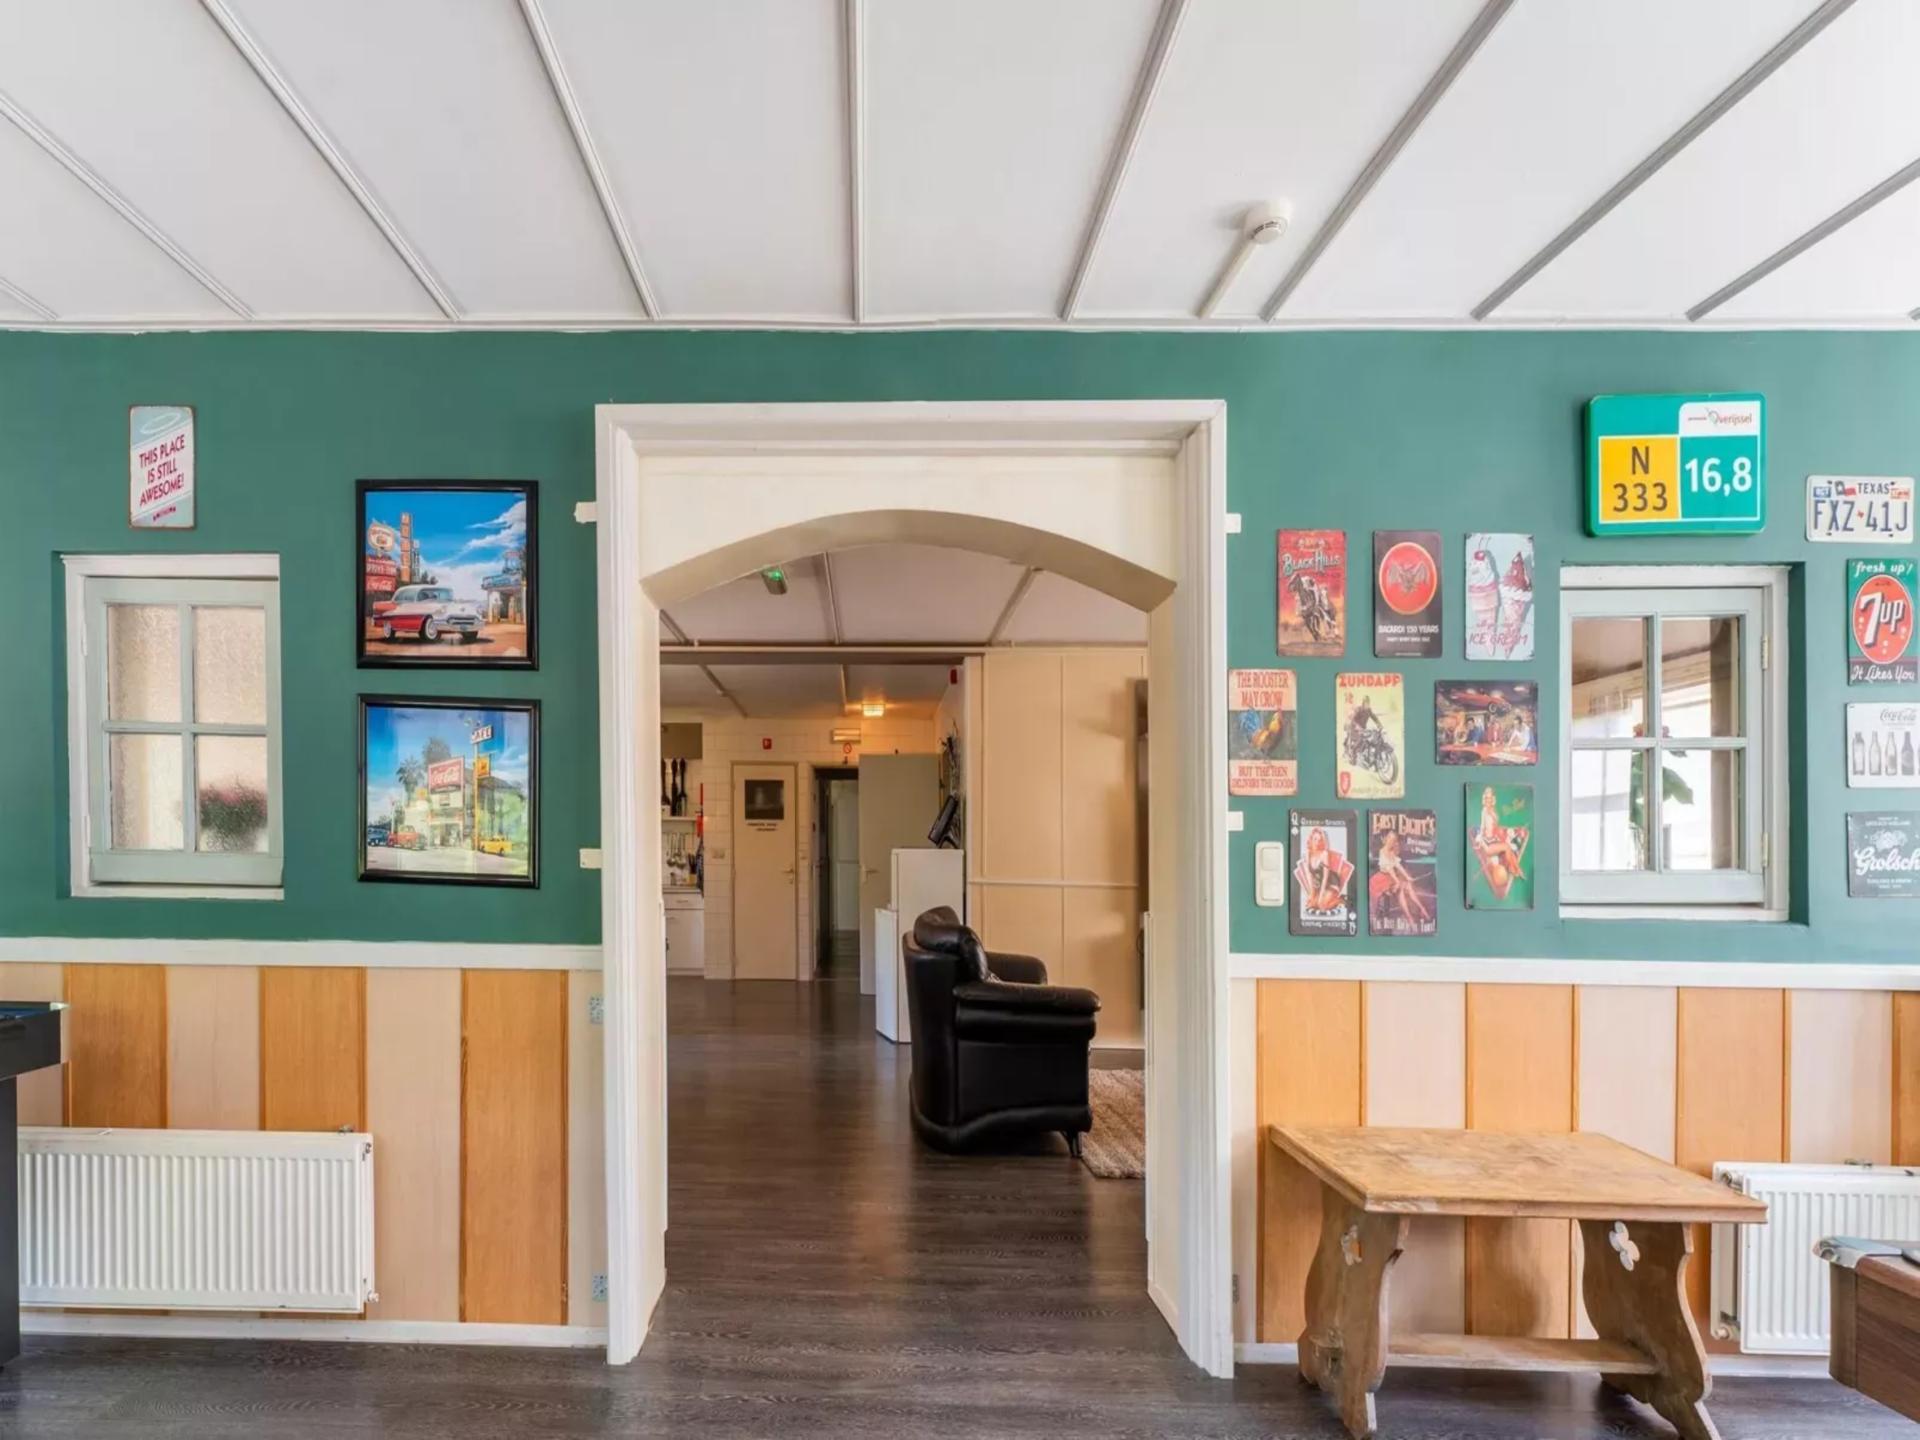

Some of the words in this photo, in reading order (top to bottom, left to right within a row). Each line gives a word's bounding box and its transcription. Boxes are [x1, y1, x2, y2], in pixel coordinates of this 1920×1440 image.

[139, 447, 158, 468] THIS
[160, 434, 185, 459] PLACE
[1631, 446, 1650, 475] N
[147, 468, 155, 484] IS
[157, 458, 178, 480] STILL
[1685, 456, 1752, 497] 16,8
[140, 472, 184, 506] AWESOME!
[1613, 482, 1667, 512] 333
[1857, 482, 1890, 494] TEXAS
[1378, 625, 1405, 634] BACARDI
[1419, 625, 1439, 635] YEARS
[1469, 633, 1487, 645] ICE
[1236, 671, 1252, 688] THE
[1253, 672, 1289, 688] ROOSTER
[1864, 665, 1892, 683] Likes
[1895, 665, 1914, 683] You
[1241, 691, 1259, 707] MAY
[1260, 691, 1283, 708] CROW
[1238, 766, 1252, 777] BUT
[1853, 846, 1920, 876] Grolsch
